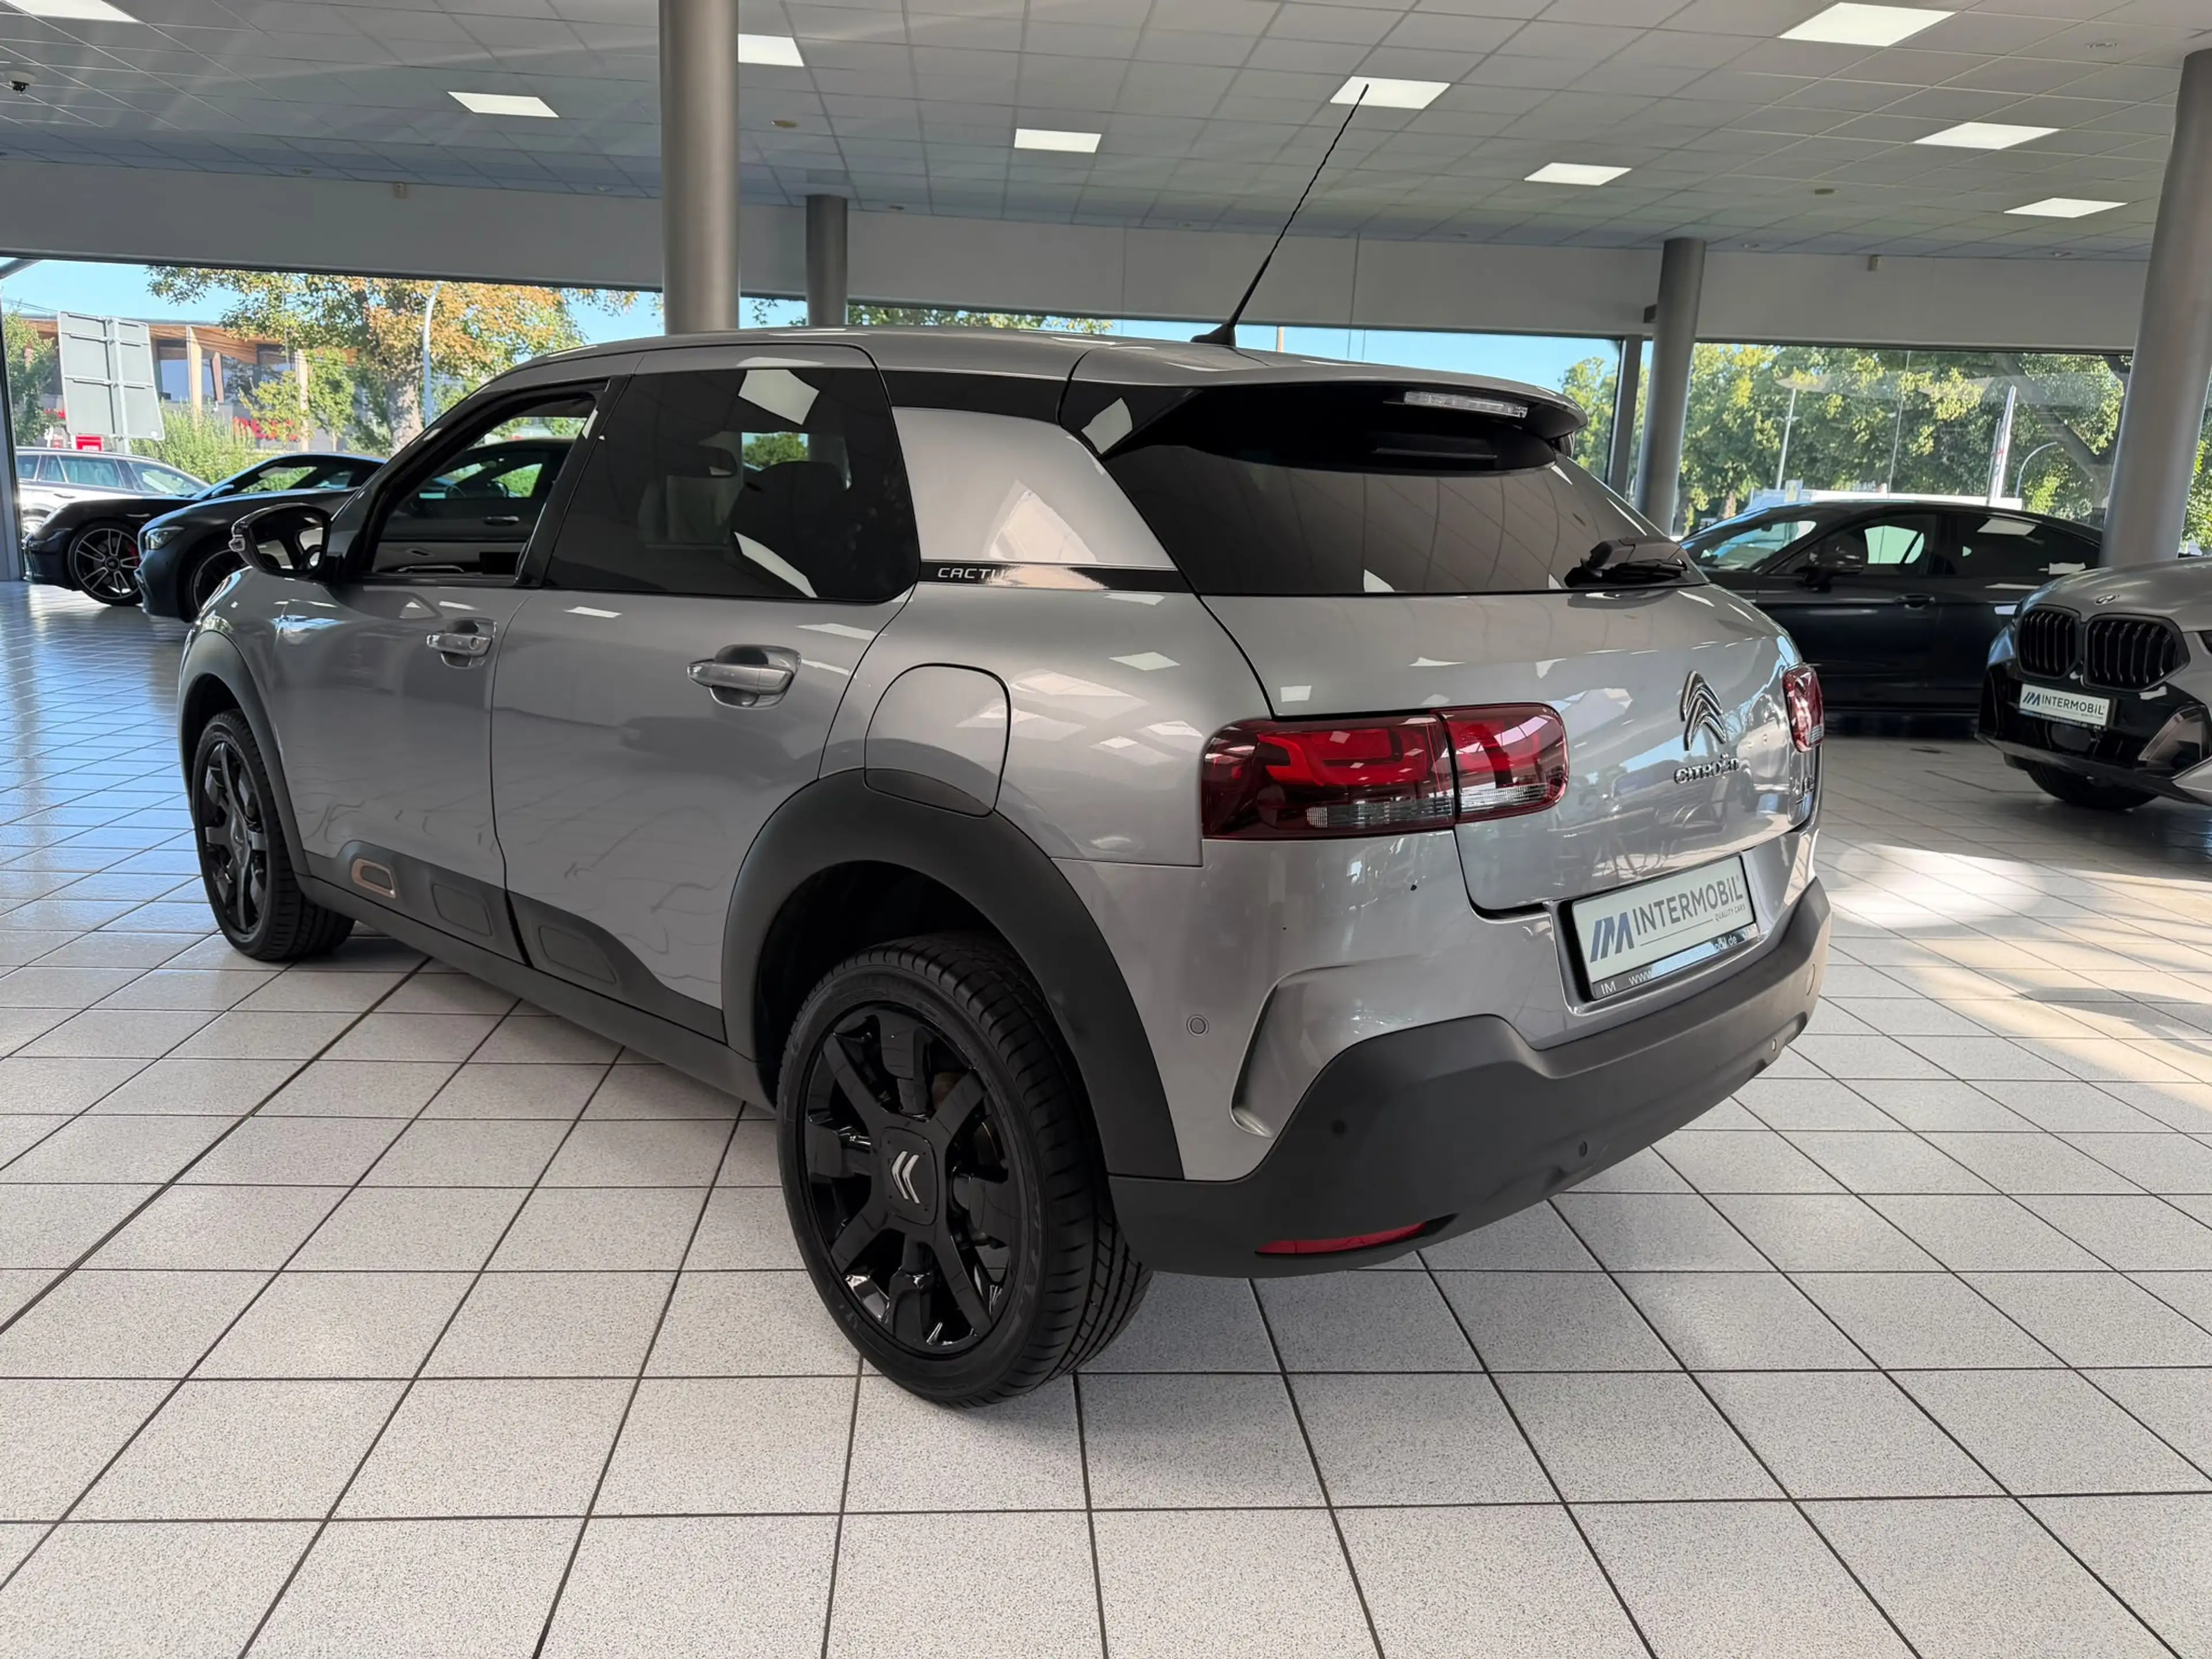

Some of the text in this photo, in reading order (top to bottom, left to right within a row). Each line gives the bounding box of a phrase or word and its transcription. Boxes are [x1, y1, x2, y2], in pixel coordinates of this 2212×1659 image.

[937, 567, 1012, 581] CACTU
[2041, 694, 2104, 715] INTERMOBIL
[1633, 876, 1744, 935] INTERMOBIL
[1600, 980, 1617, 995] IM
